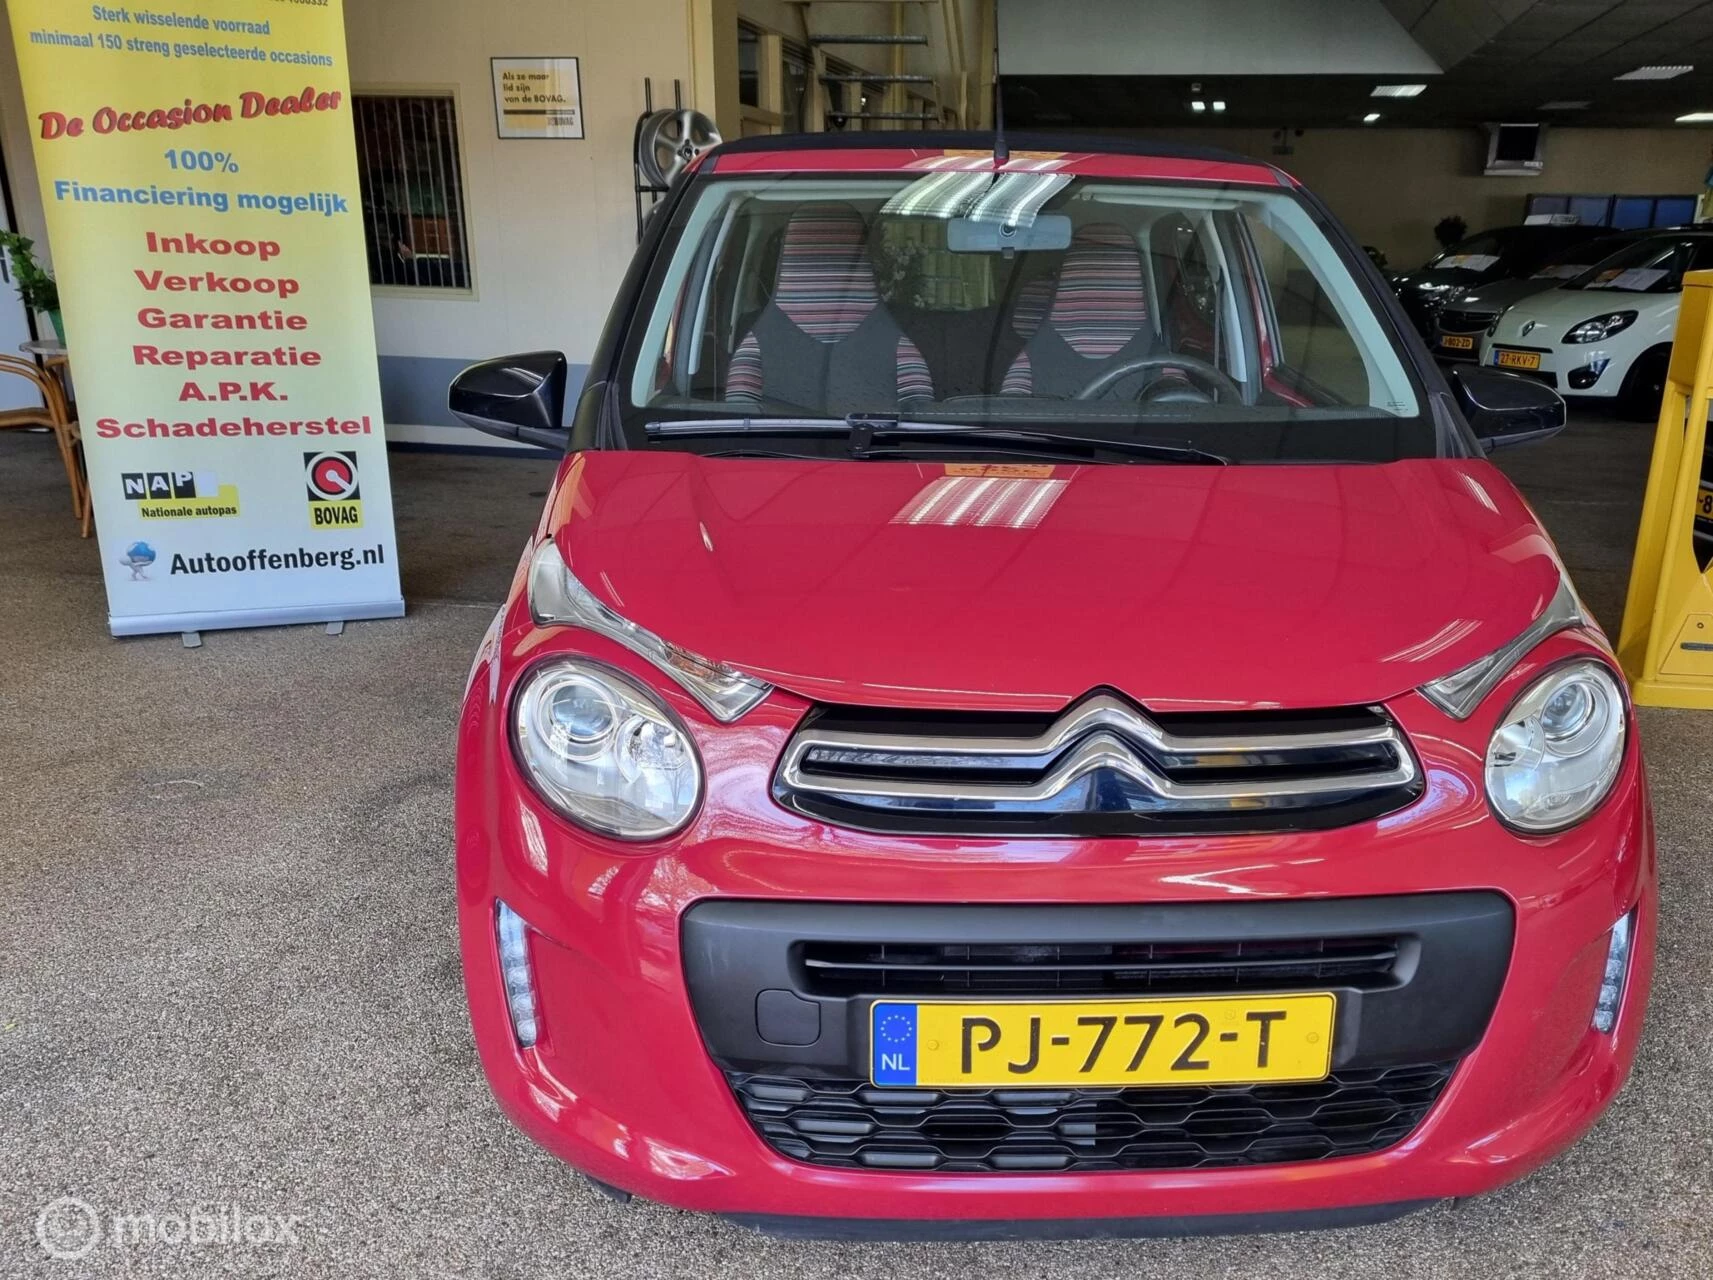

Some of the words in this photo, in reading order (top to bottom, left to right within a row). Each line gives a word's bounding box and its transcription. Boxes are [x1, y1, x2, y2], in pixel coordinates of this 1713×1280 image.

[92, 5, 130, 24] Sterk
[135, 11, 209, 31] wisselende
[213, 18, 270, 35] voorraad
[30, 30, 94, 49] minimaal
[97, 33, 122, 50] 150
[127, 36, 170, 58] streng
[174, 42, 266, 62] geselecteerde
[270, 50, 332, 66] occasions
[503, 83, 513, 91] lid
[522, 94, 532, 103] de
[534, 95, 567, 103] BOVAG.
[39, 111, 84, 140] De
[93, 99, 232, 134] Occasion
[240, 86, 341, 119] Dealer
[164, 149, 240, 173] 100%
[54, 180, 229, 212] Financiering
[237, 192, 348, 217] mogelijk
[146, 231, 281, 261] Inkoop
[134, 270, 300, 298] Verkoop
[137, 308, 308, 330] Garantie
[133, 346, 322, 370] Reparatie
[178, 382, 288, 401] A.P.K.
[96, 416, 372, 438] Schadeherstel
[124, 471, 193, 495] NAP
[141, 504, 193, 518] Nationale
[195, 505, 237, 517] autopas
[314, 505, 358, 526] BOVAG
[170, 544, 385, 576] Autooffenberg.nl
[961, 1010, 1287, 1074] PJ-772-T
[881, 1053, 910, 1071] NL
